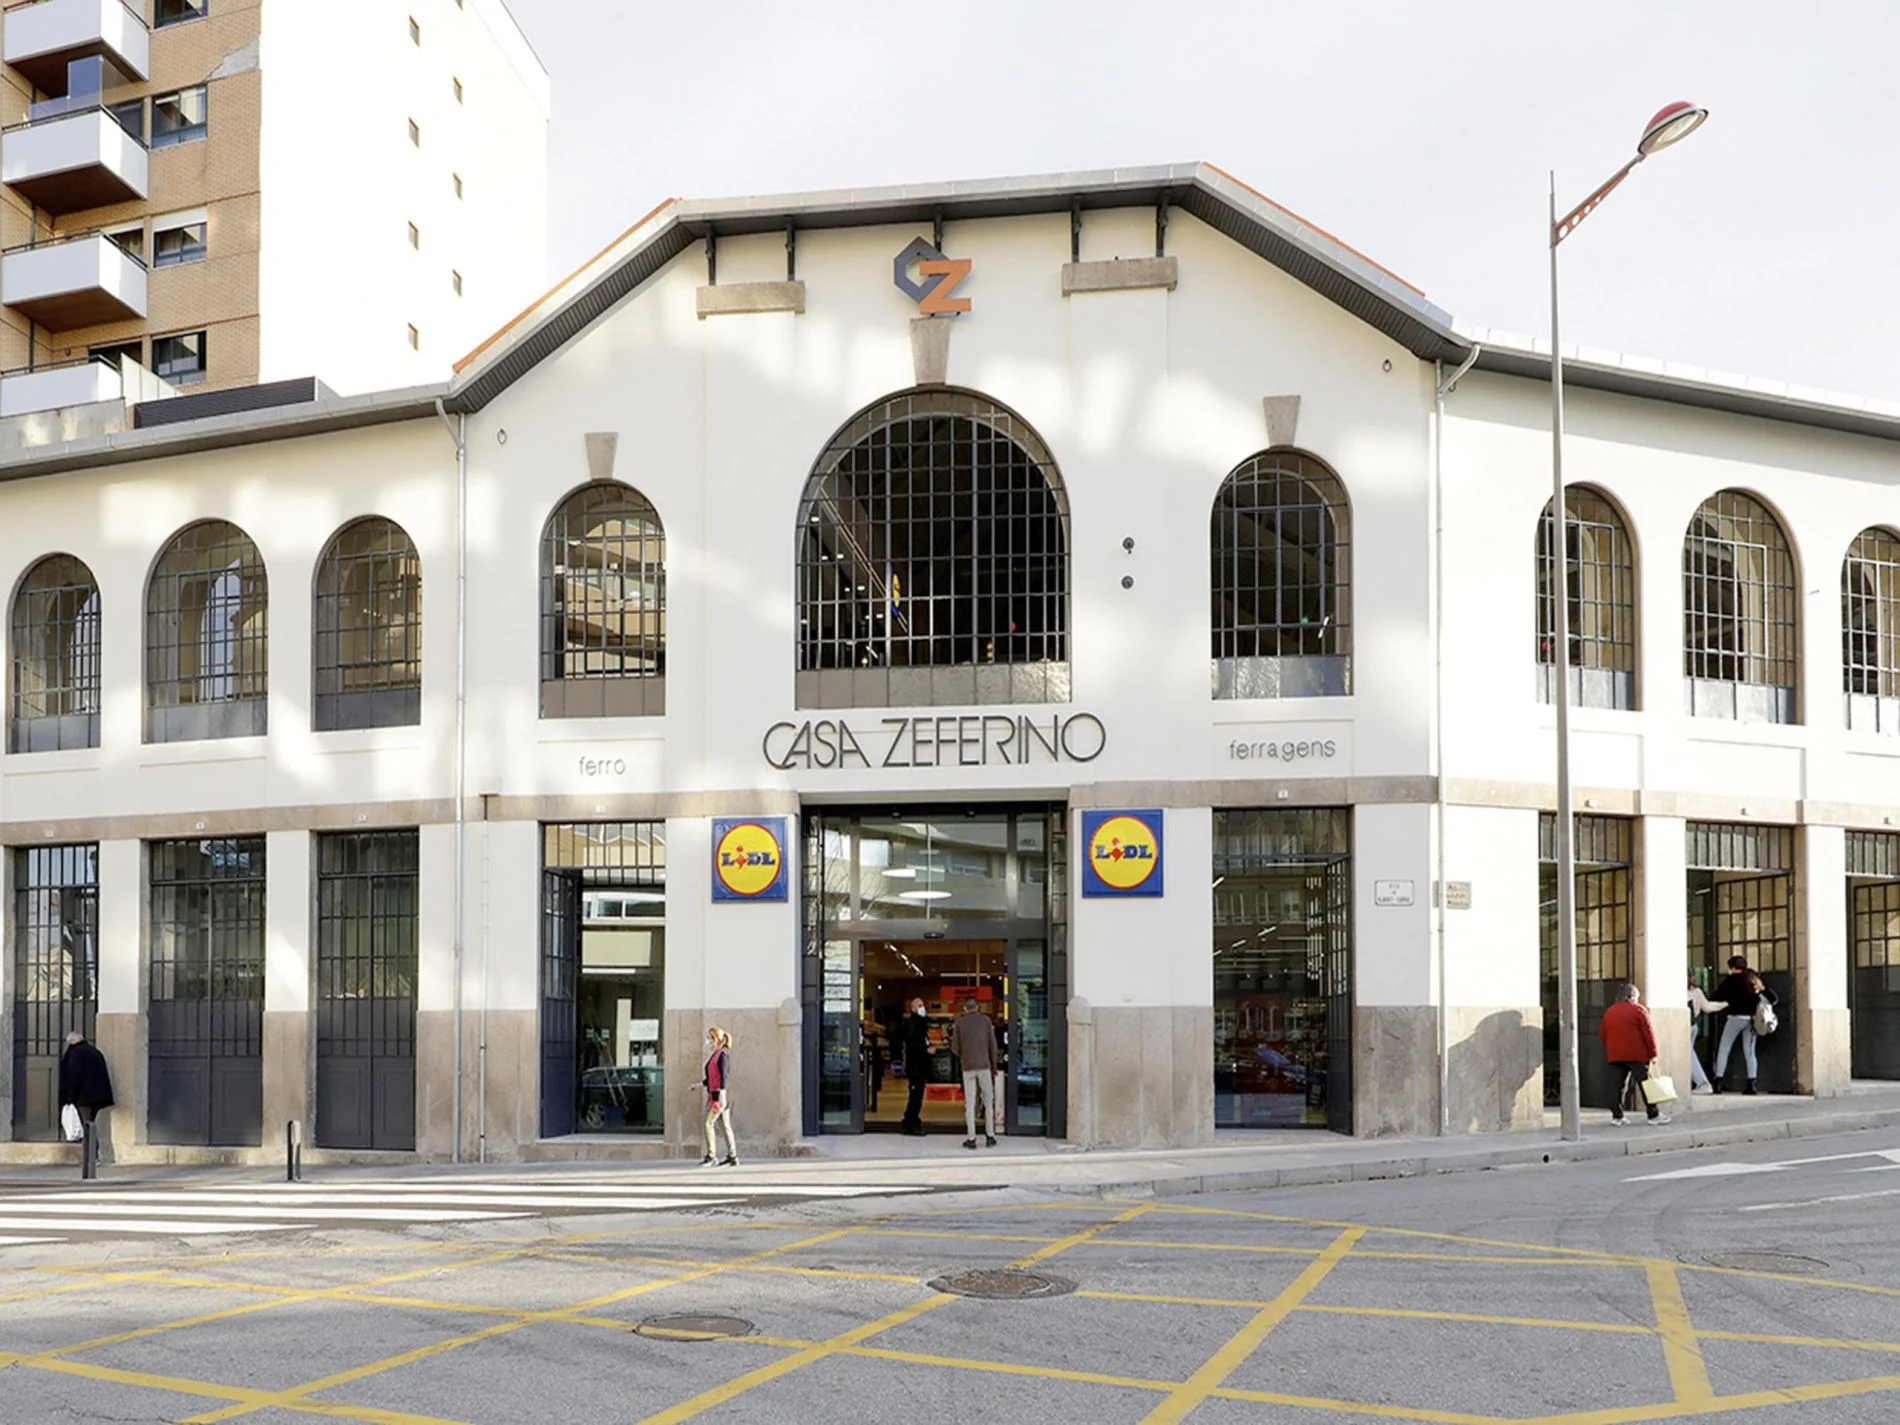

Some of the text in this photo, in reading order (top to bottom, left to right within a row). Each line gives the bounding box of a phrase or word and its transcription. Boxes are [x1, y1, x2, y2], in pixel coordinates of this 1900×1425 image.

[763, 713, 1106, 770] CASA ZEFERINO
[1229, 739, 1336, 762] ferragens
[579, 755, 626, 776] ferro
